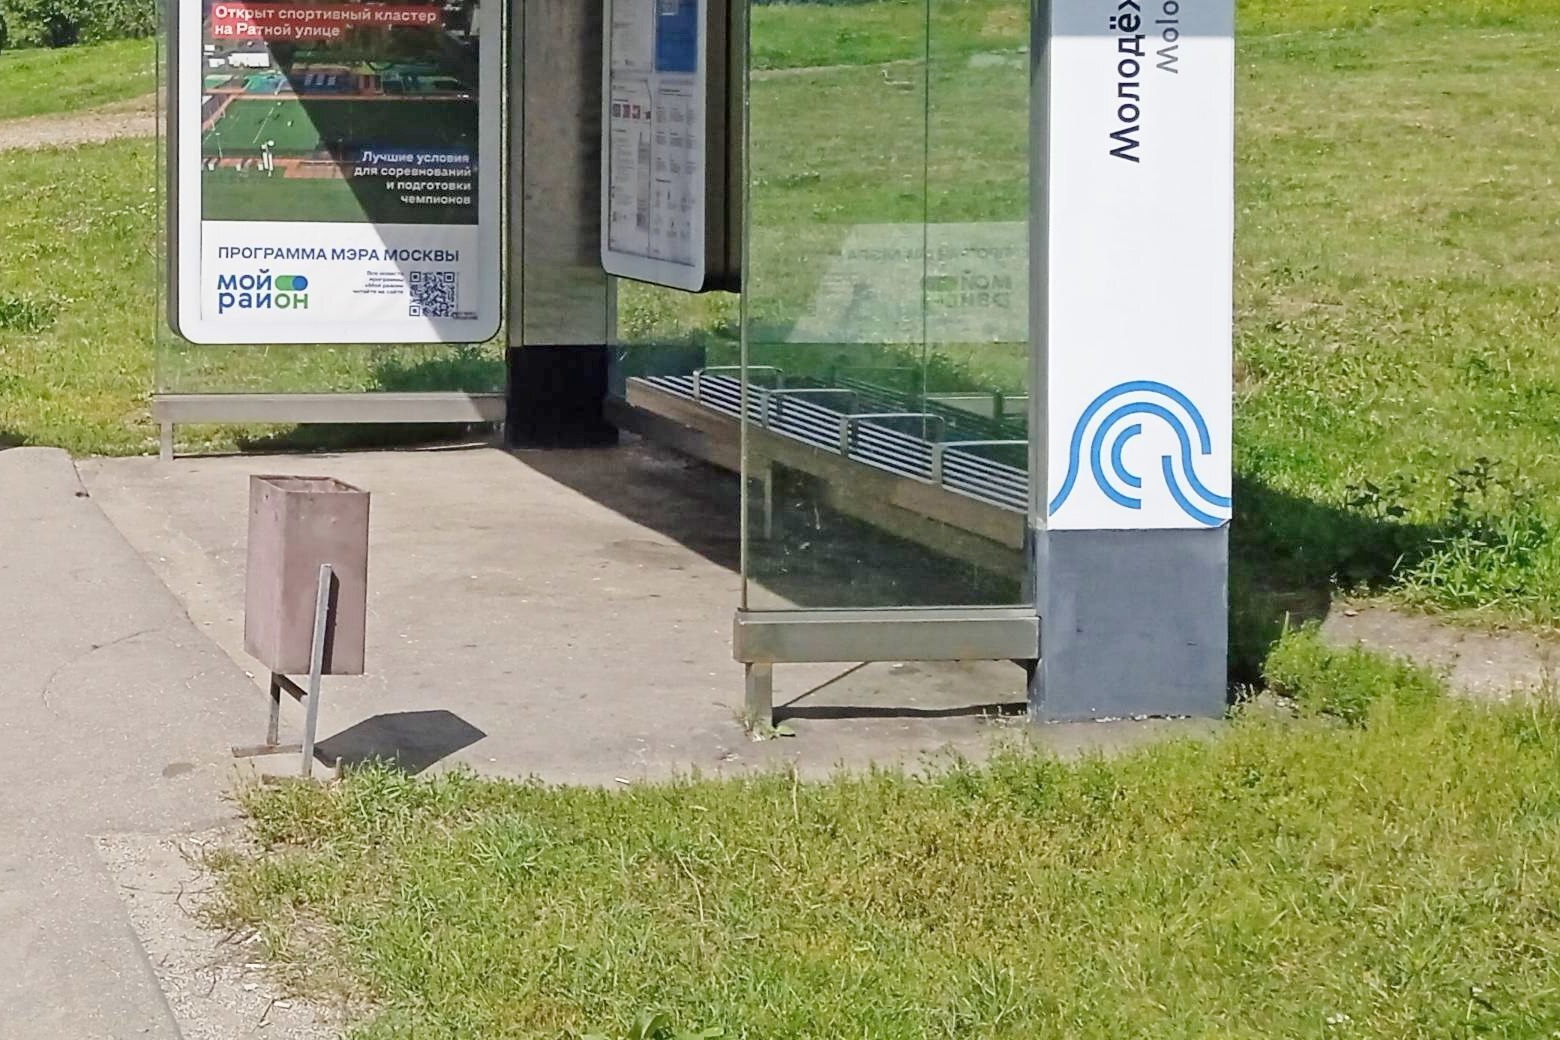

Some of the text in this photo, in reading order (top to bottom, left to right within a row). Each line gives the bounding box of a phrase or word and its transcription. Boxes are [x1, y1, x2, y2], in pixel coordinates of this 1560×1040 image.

[215, 5, 437, 26] Открыт спортивный кластер
[214, 23, 340, 40] на Ратной улице
[362, 151, 470, 165] Лучшие условия
[354, 166, 472, 177] для соревнований
[386, 181, 471, 191] и подготовки
[400, 195, 471, 205] чемпионов
[218, 246, 460, 262] ПРОГРАММА МЭРА МОСКВЫ
[217, 268, 272, 291] мой
[218, 293, 309, 315] район
